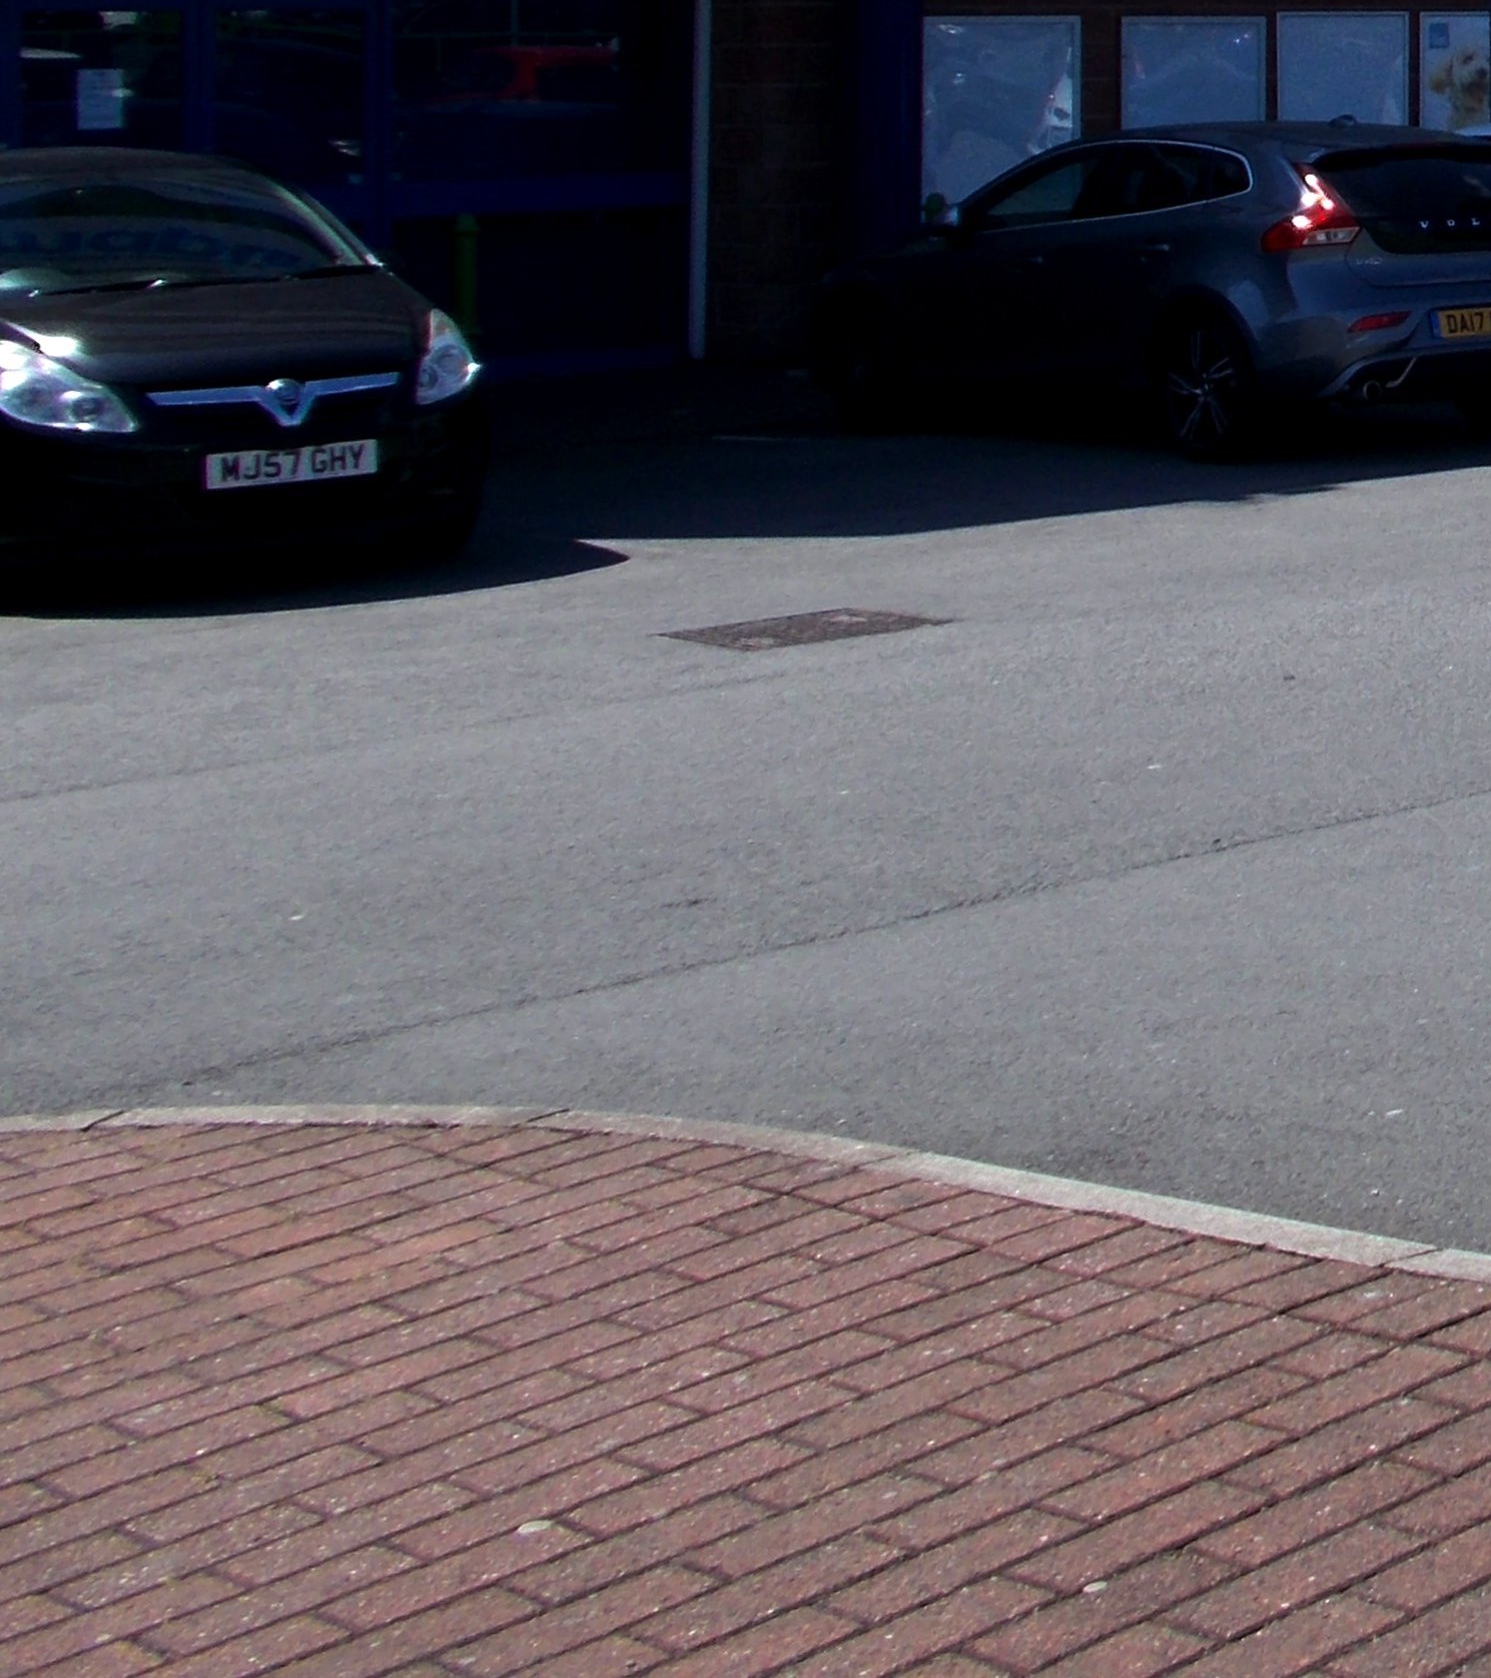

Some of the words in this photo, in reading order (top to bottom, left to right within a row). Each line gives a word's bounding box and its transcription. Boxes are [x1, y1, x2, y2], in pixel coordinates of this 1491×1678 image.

[1445, 312, 1484, 334] DA17
[219, 450, 301, 482] MJ57
[310, 443, 365, 473] GHY
